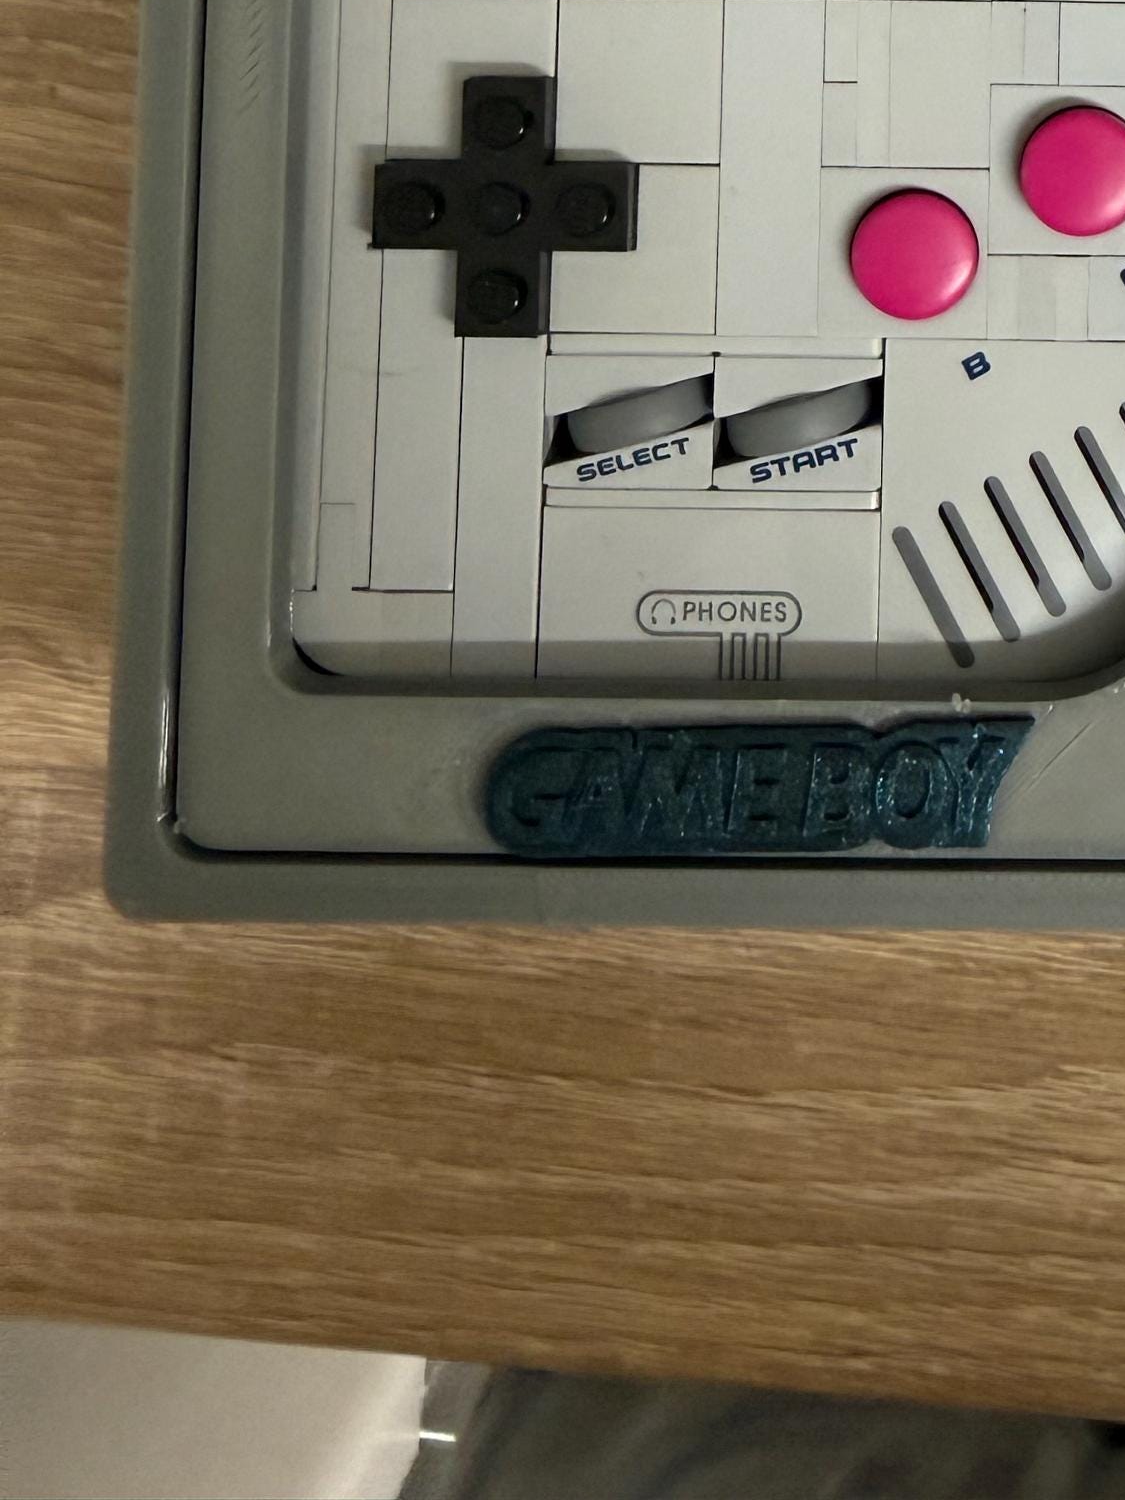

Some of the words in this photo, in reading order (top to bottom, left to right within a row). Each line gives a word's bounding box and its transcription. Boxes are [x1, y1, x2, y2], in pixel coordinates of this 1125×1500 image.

[961, 351, 992, 381] B
[576, 437, 690, 482] SELECT
[749, 438, 859, 484] START
[682, 600, 787, 622] PHONES
